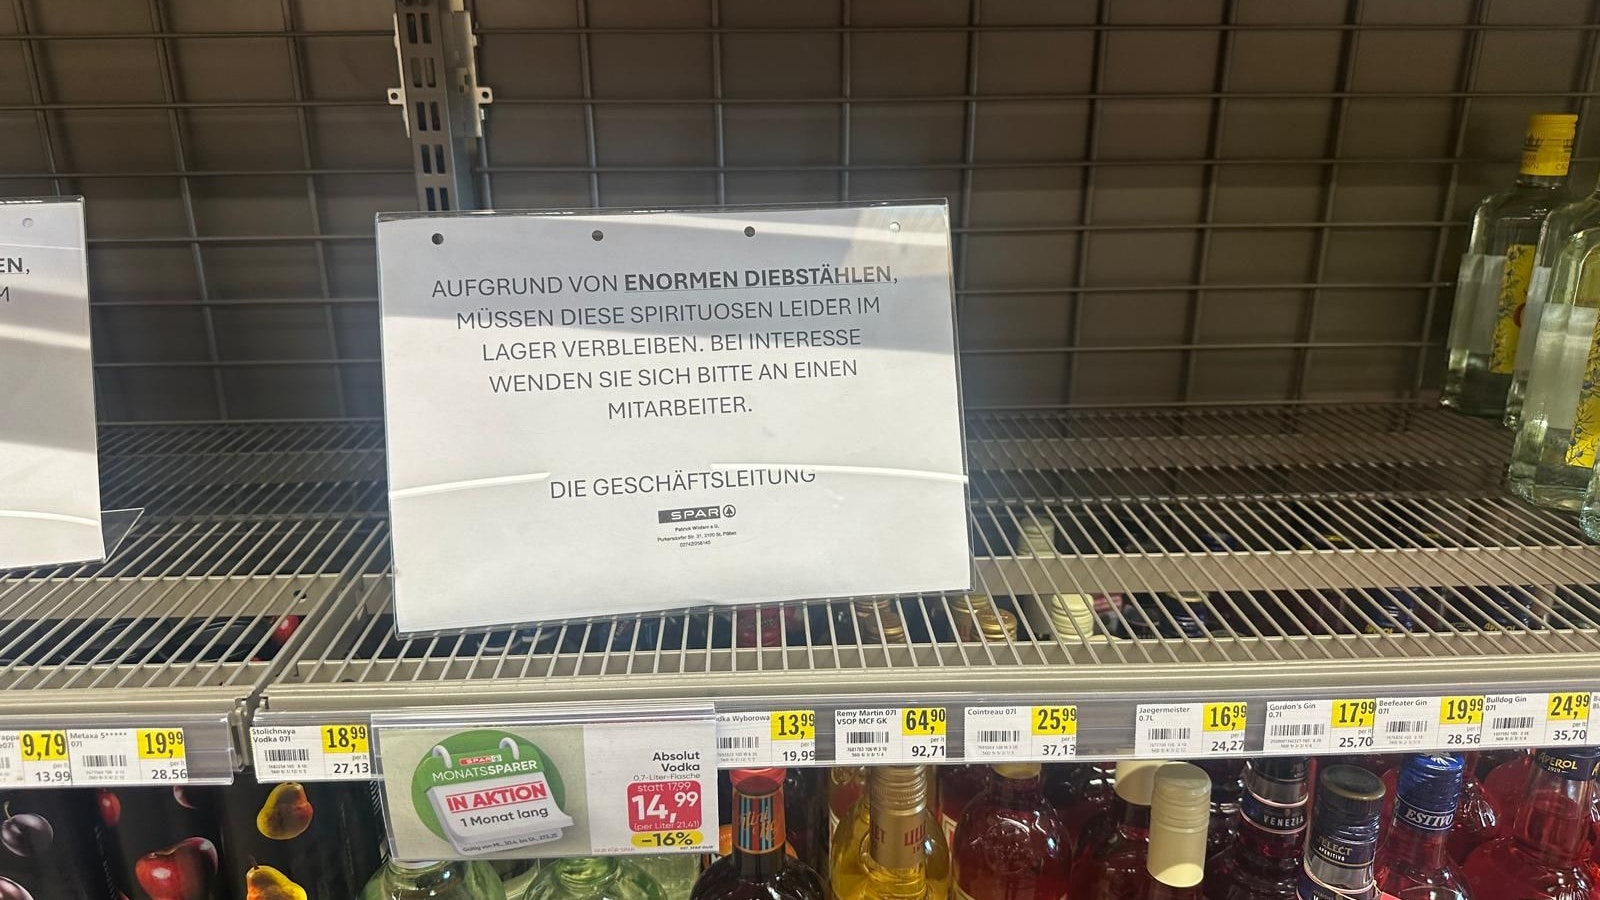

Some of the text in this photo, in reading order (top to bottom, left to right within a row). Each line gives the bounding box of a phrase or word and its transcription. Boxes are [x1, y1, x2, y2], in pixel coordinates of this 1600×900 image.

[432, 264, 898, 297] AUFGRUND VON ENORMEN DIEBSTÄHLEN,
[457, 296, 880, 329] MÜSSEN DIESE SPIRITUOSEN LEIDER IM
[482, 328, 861, 361] LAGER VERBLEIBEN. BEI INTERESSE
[489, 359, 857, 393] WENDEN SIE SICH BITTE AN EINEN
[608, 396, 753, 419] MITARBEITER.
[550, 468, 816, 499] DIE GESCHÄFTSLEITUNG
[671, 508, 719, 520] SPAR
[1269, 703, 1302, 711] Gordon's
[1486, 696, 1513, 704] Bulldog
[1551, 695, 1590, 719] 24,99
[732, 714, 770, 723] Wyborowa
[1210, 705, 1246, 730] 16,99
[1339, 701, 1375, 726] 17,99
[1446, 698, 1483, 723] 19,99
[778, 714, 814, 739] 13,99
[906, 709, 945, 734] 64,90
[1038, 708, 1076, 734] 25,99
[327, 726, 366, 752] 18,99
[1339, 737, 1373, 748] 25,70
[1447, 734, 1480, 745] 28,56
[1553, 730, 1586, 741] 35,70
[22, 733, 66, 760] 9,79
[144, 731, 184, 758] 19,99
[912, 745, 945, 758] 92,71
[1042, 744, 1076, 756] 37,13
[1211, 741, 1245, 752] 24,27
[652, 751, 700, 761] Absolut
[783, 751, 815, 762] 19,99
[1540, 752, 1578, 770] APEROL
[152, 769, 187, 780] 28,56
[334, 763, 369, 774] 27,13
[432, 760, 537, 782] MONATSSPARER
[661, 763, 700, 772] Vodka
[35, 771, 71, 782] 13,99
[633, 773, 701, 782] 0,7-Liter-Flasche
[638, 782, 691, 792] statt 17,99
[446, 783, 547, 811] IN AKTION
[631, 791, 698, 823] 14,99
[460, 807, 549, 827] 1 Monat lang
[634, 819, 700, 831] (per Liter 21,41)
[1263, 815, 1304, 827] VENEZIA
[1405, 808, 1454, 827] ESTIVO
[642, 832, 693, 846] -16%
[1318, 847, 1345, 862] APERITIVO
